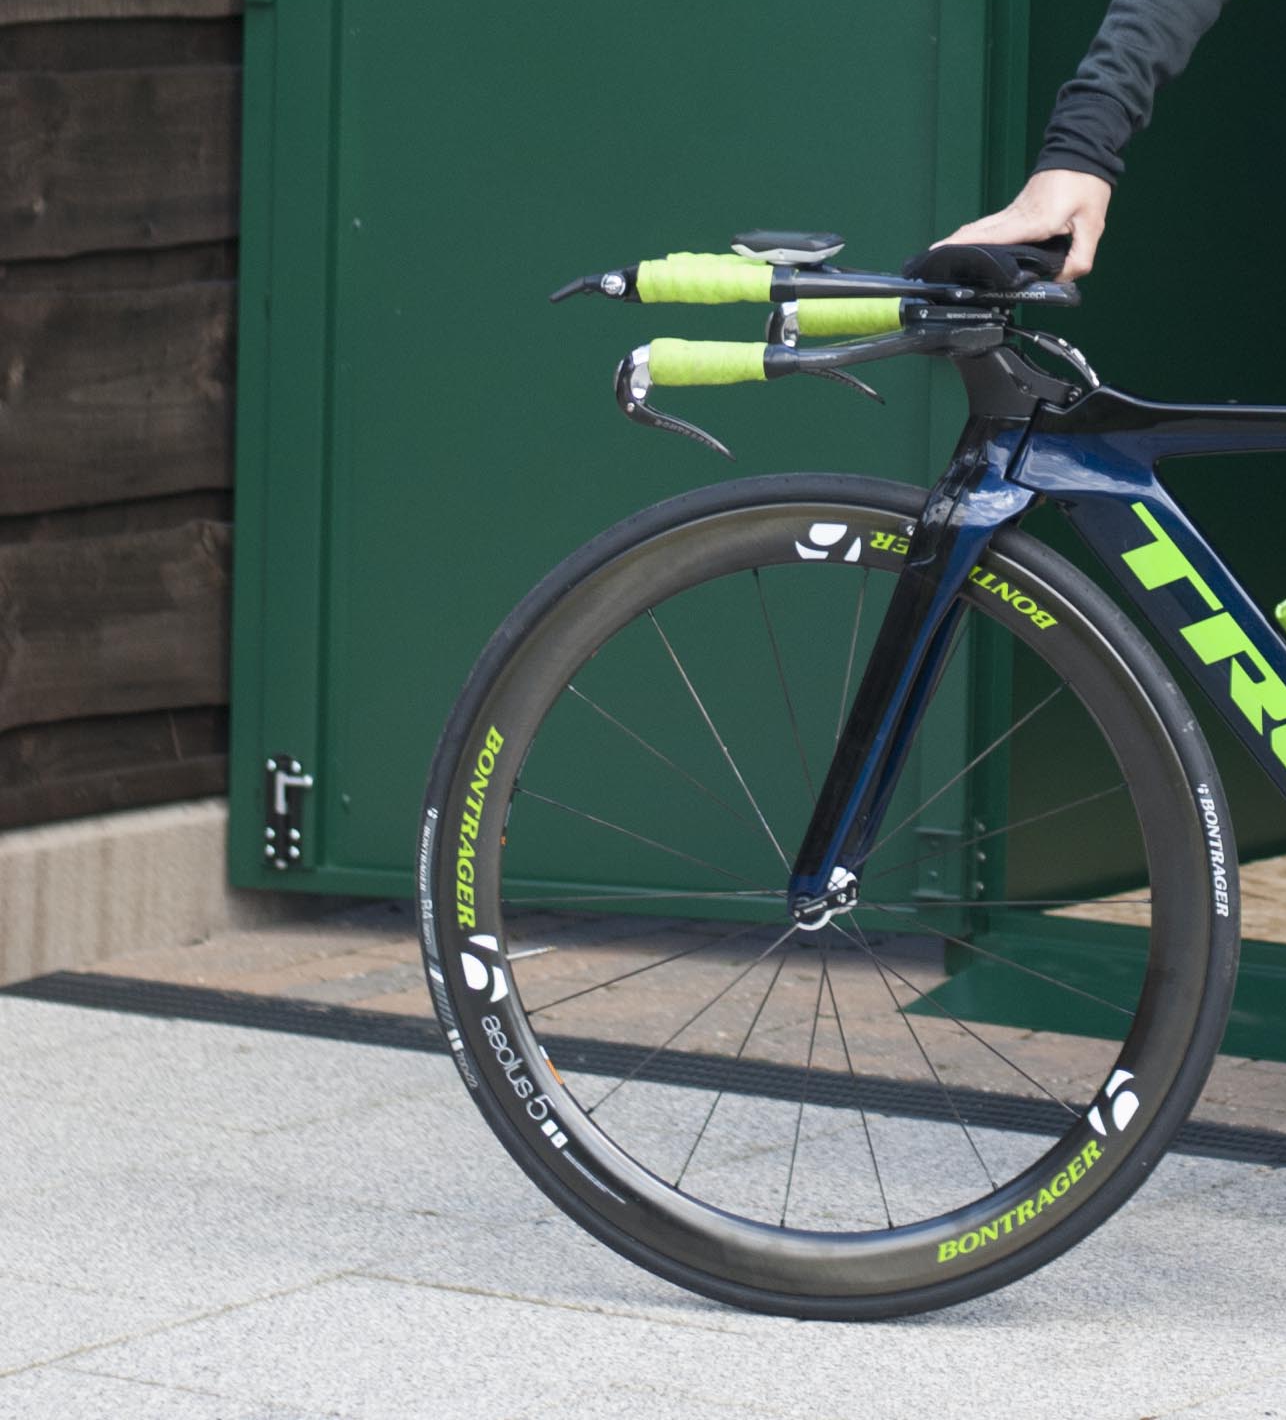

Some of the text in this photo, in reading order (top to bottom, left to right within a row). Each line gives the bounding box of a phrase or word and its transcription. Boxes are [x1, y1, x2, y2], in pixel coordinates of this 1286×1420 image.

[455, 726, 505, 930] BONTRAGER
[1200, 798, 1229, 917] BONTRAGER
[481, 1015, 555, 1120] aeolus 5
[937, 1140, 1103, 1263] BONTRAGER
